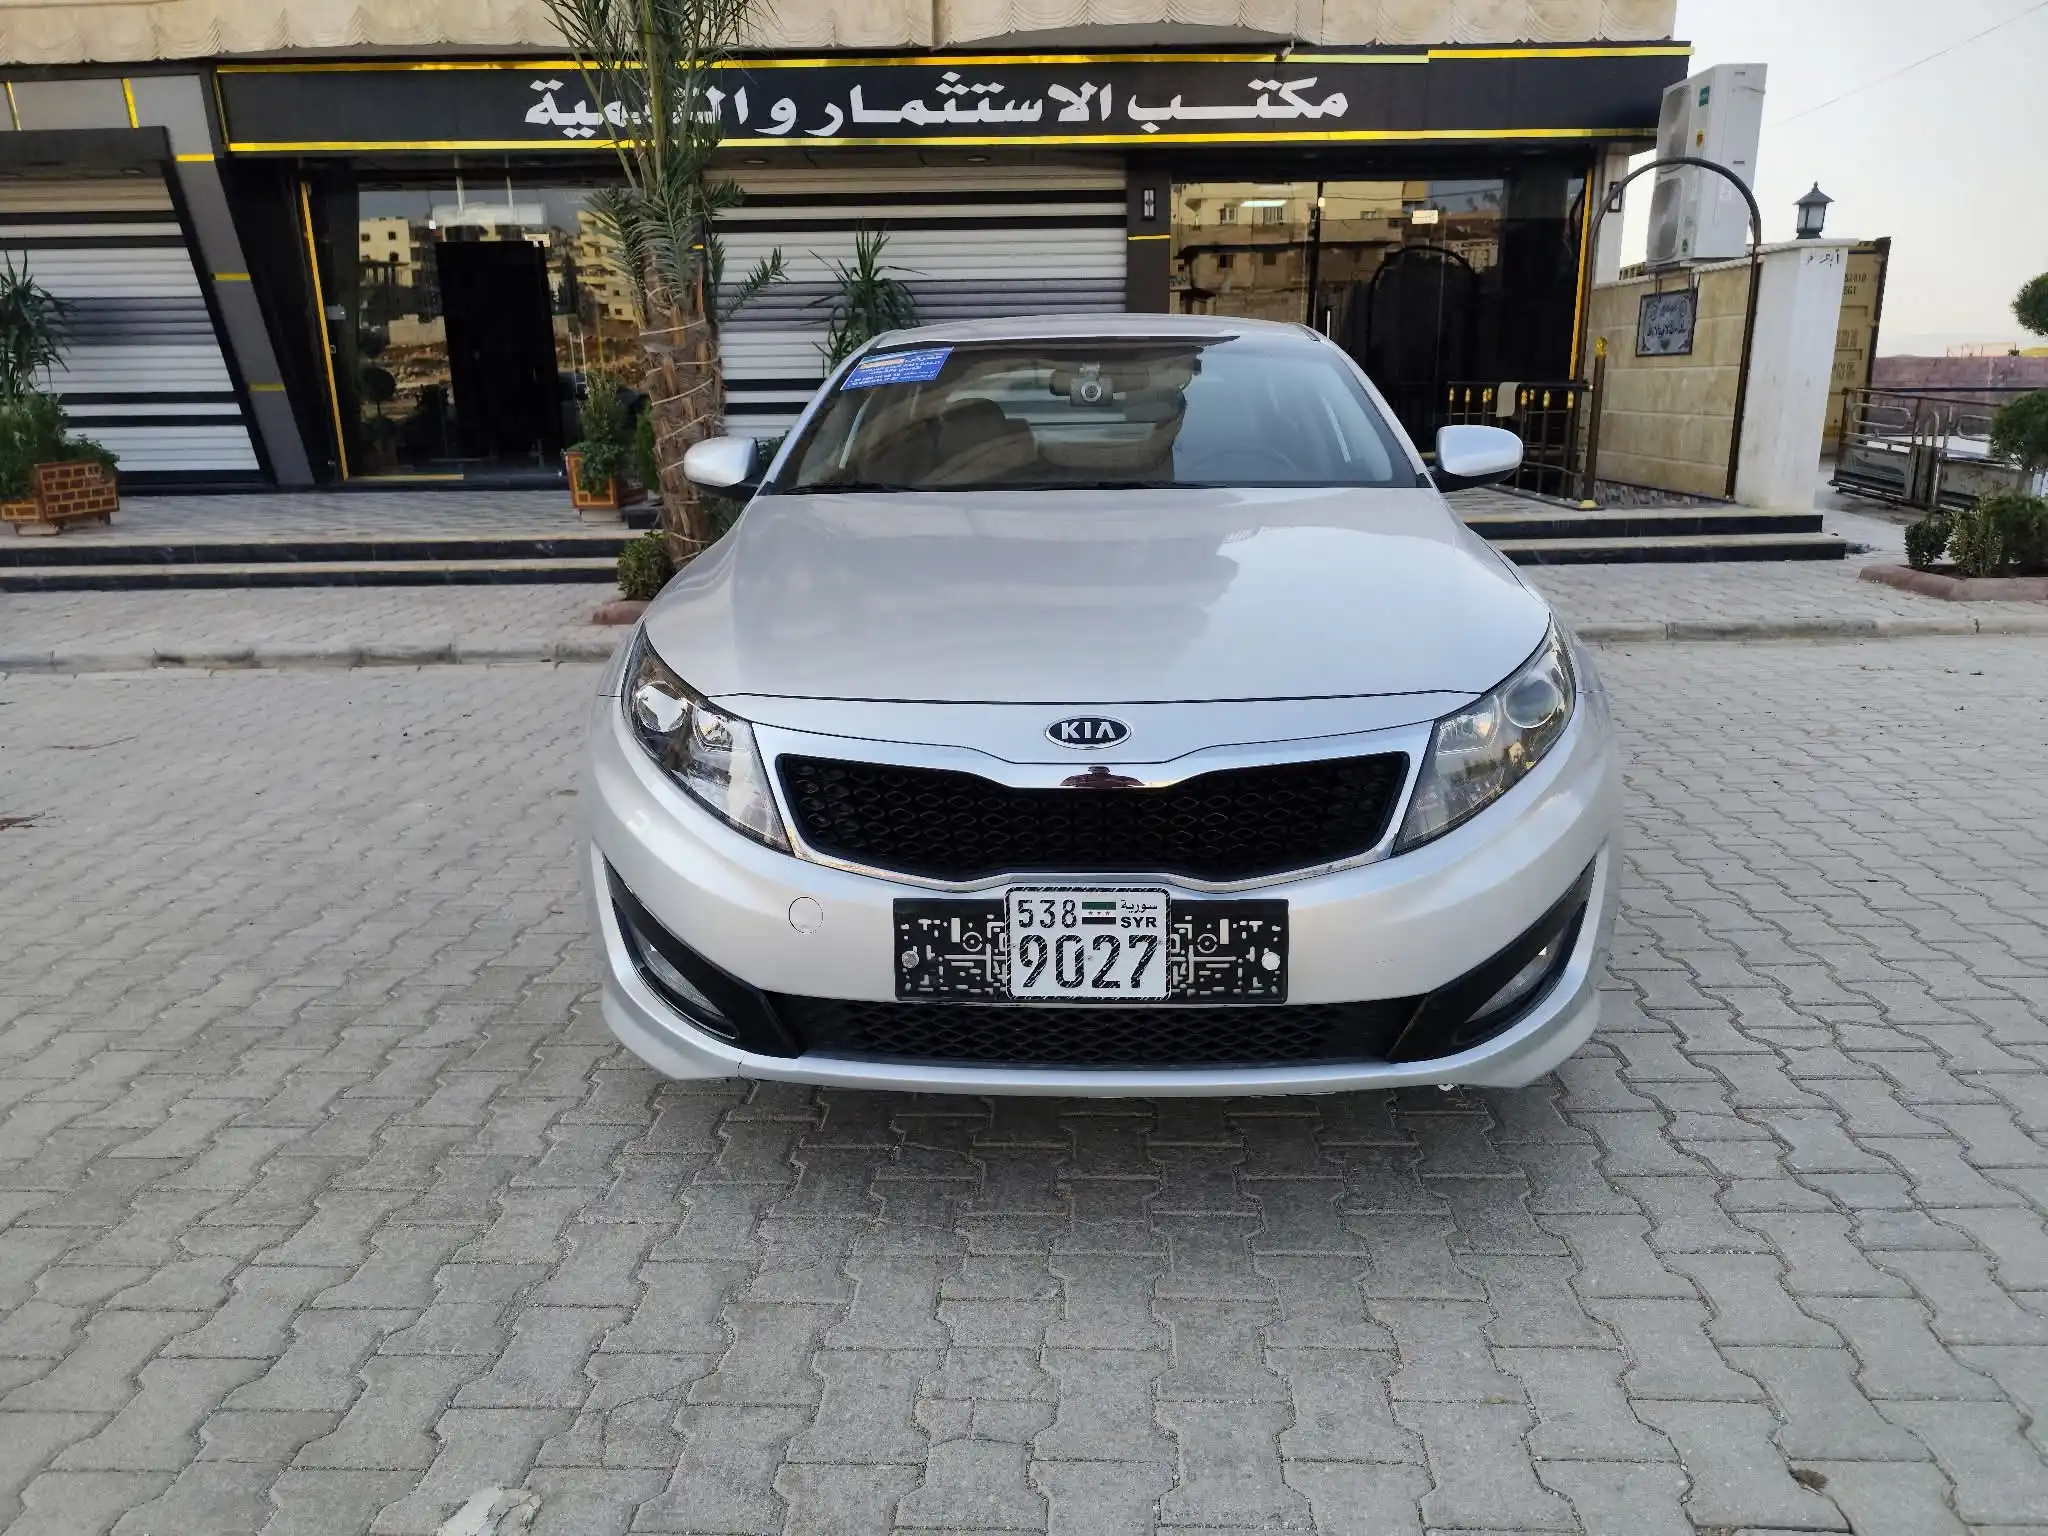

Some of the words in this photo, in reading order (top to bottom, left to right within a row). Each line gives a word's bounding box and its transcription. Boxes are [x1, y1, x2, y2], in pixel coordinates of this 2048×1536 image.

[753, 97, 797, 135] و
[804, 70, 1112, 136] الاستثمار
[1128, 77, 1348, 133] مكتب
[1061, 721, 1116, 739] KIA
[1018, 899, 1077, 928] 538
[1121, 899, 1158, 914] سورية
[1121, 916, 1157, 928] SYR
[1019, 934, 1158, 989] 9027
